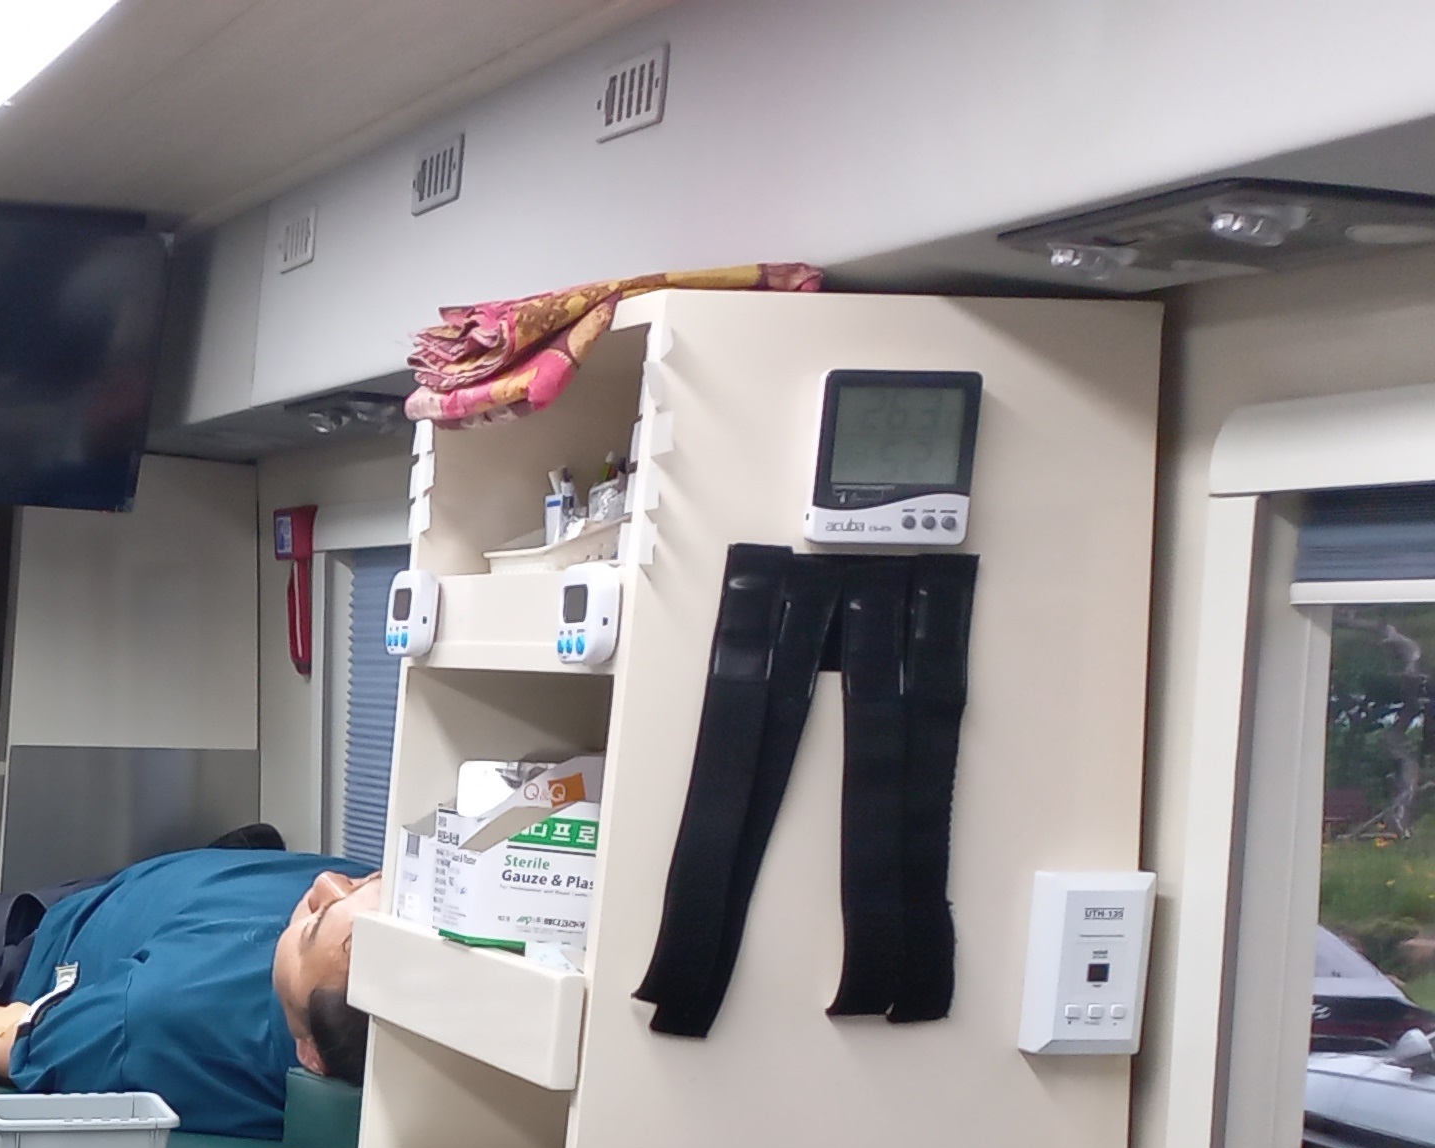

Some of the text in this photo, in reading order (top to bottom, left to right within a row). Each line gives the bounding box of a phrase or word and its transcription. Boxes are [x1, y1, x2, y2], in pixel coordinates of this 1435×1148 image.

[520, 822, 596, 844] 디프로
[504, 854, 551, 870] Sterile
[501, 869, 549, 886] Gauze
[551, 874, 563, 886] &
